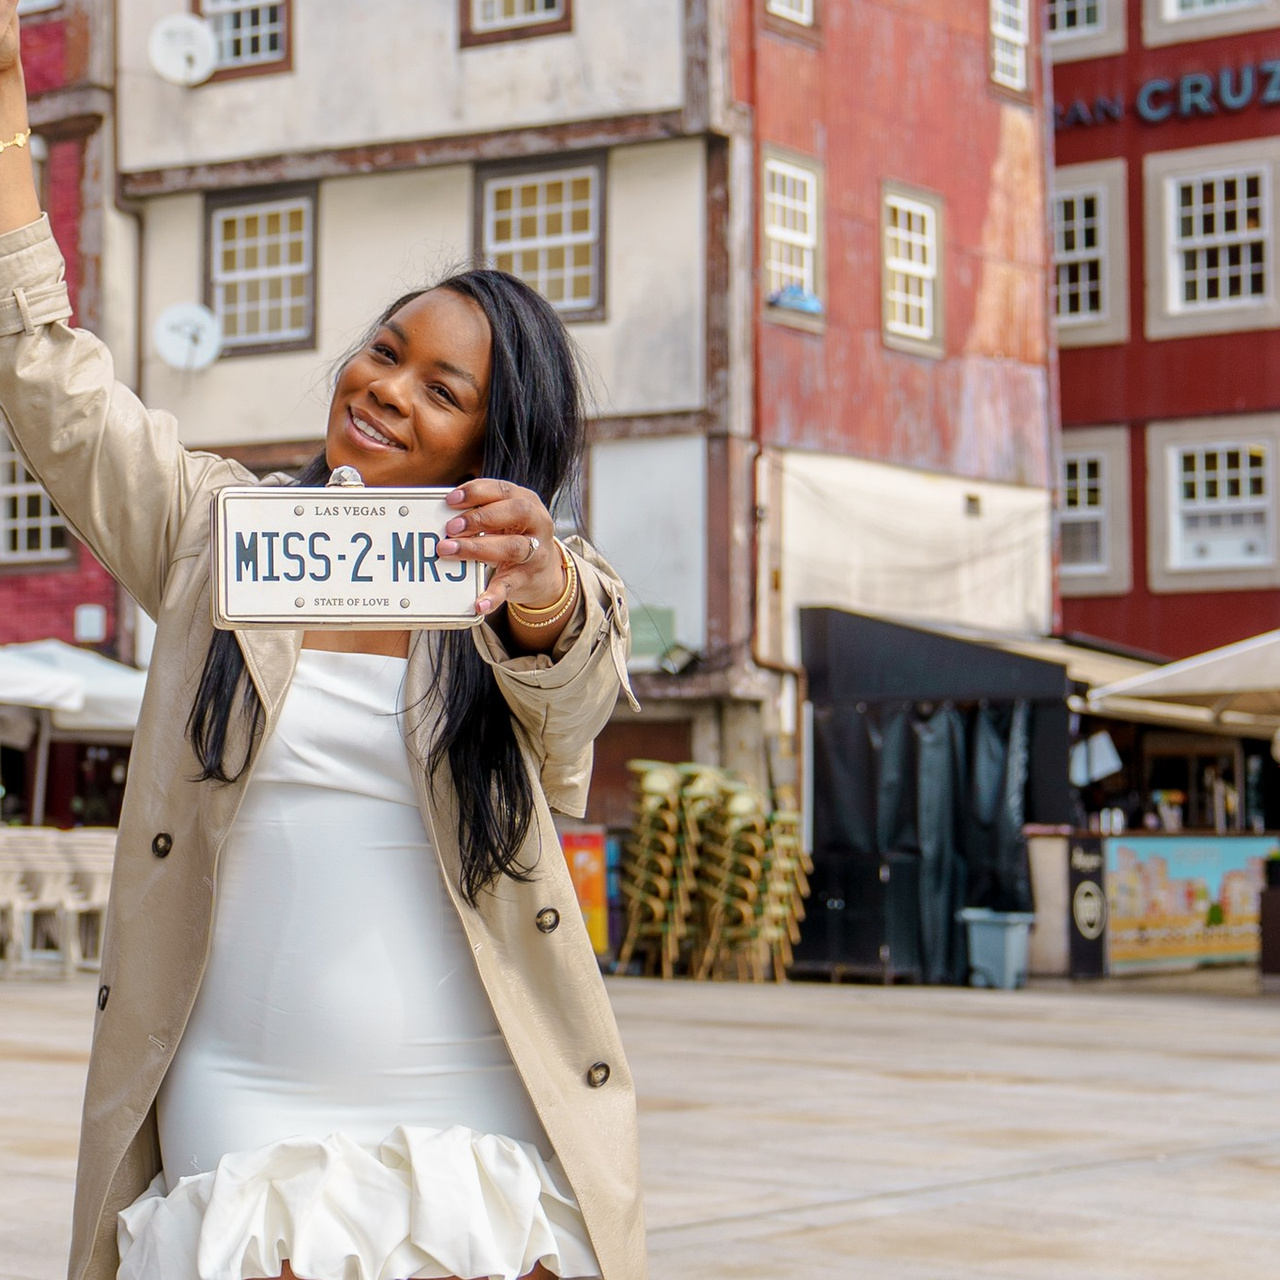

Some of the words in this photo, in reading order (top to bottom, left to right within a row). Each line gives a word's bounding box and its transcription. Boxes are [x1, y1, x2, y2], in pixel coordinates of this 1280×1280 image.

[1136, 60, 1280, 122] CRUZ
[315, 506, 339, 516] LAS
[343, 506, 386, 516] VEGAS
[314, 598, 344, 607] STATE
[346, 598, 360, 607] OF
[362, 598, 390, 607] LOVE
